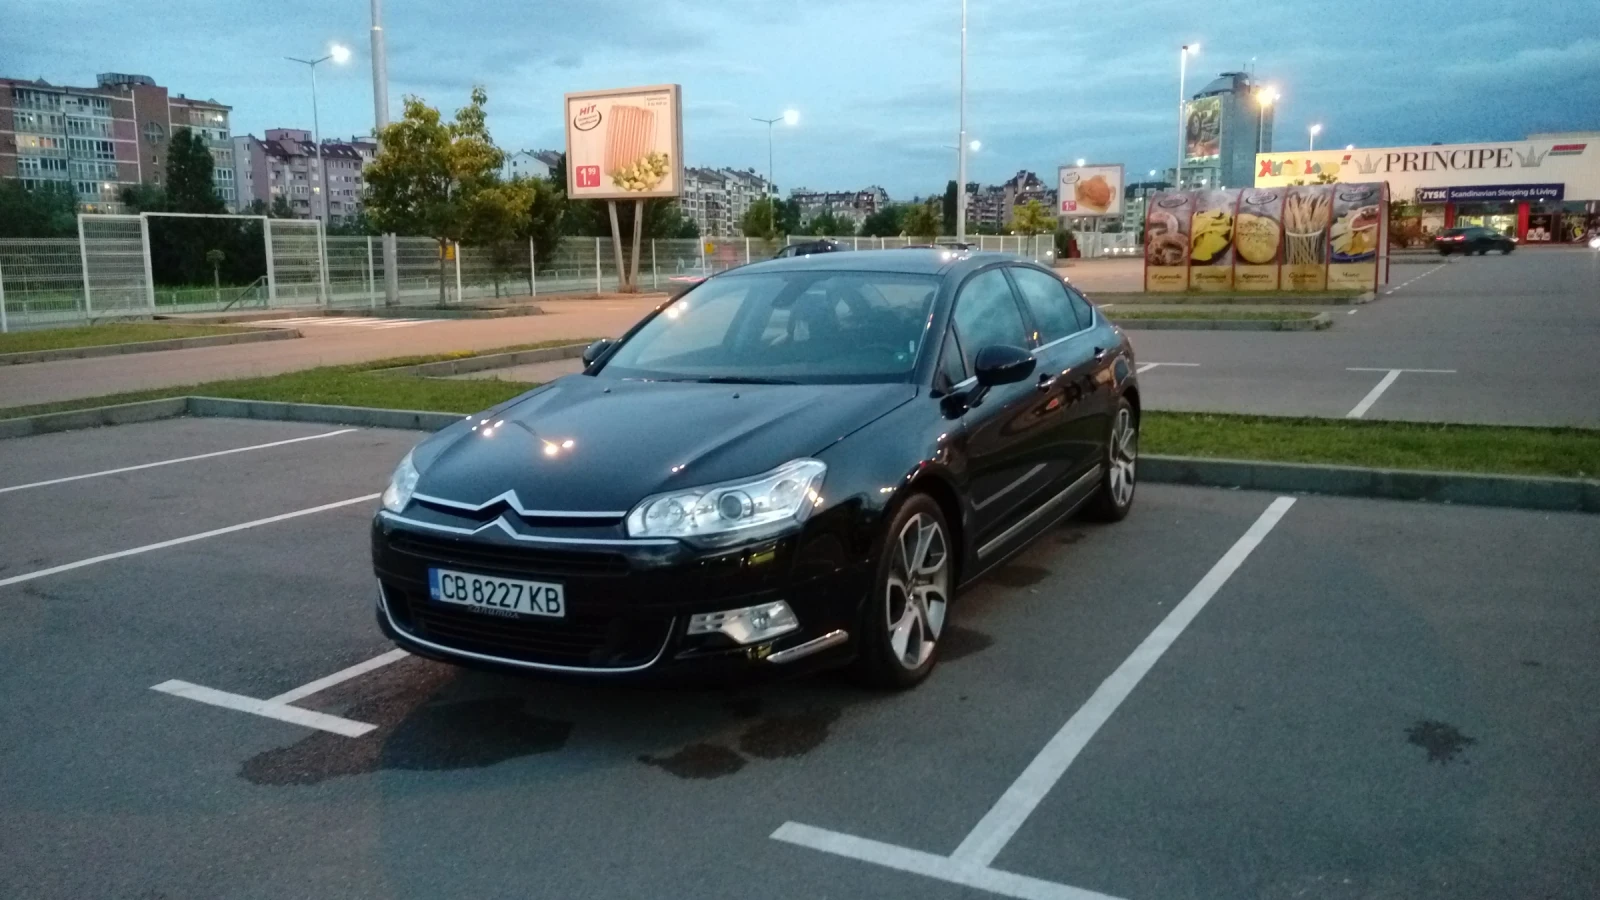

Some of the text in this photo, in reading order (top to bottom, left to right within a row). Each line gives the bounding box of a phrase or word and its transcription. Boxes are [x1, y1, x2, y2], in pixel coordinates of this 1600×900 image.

[579, 104, 596, 116] HIT
[1384, 147, 1513, 172] PRINCIPE
[1422, 190, 1447, 200] JYSK
[1450, 188, 1557, 198] Scandinavian Sleeping & Living
[441, 574, 561, 614] CB 8227 KB
